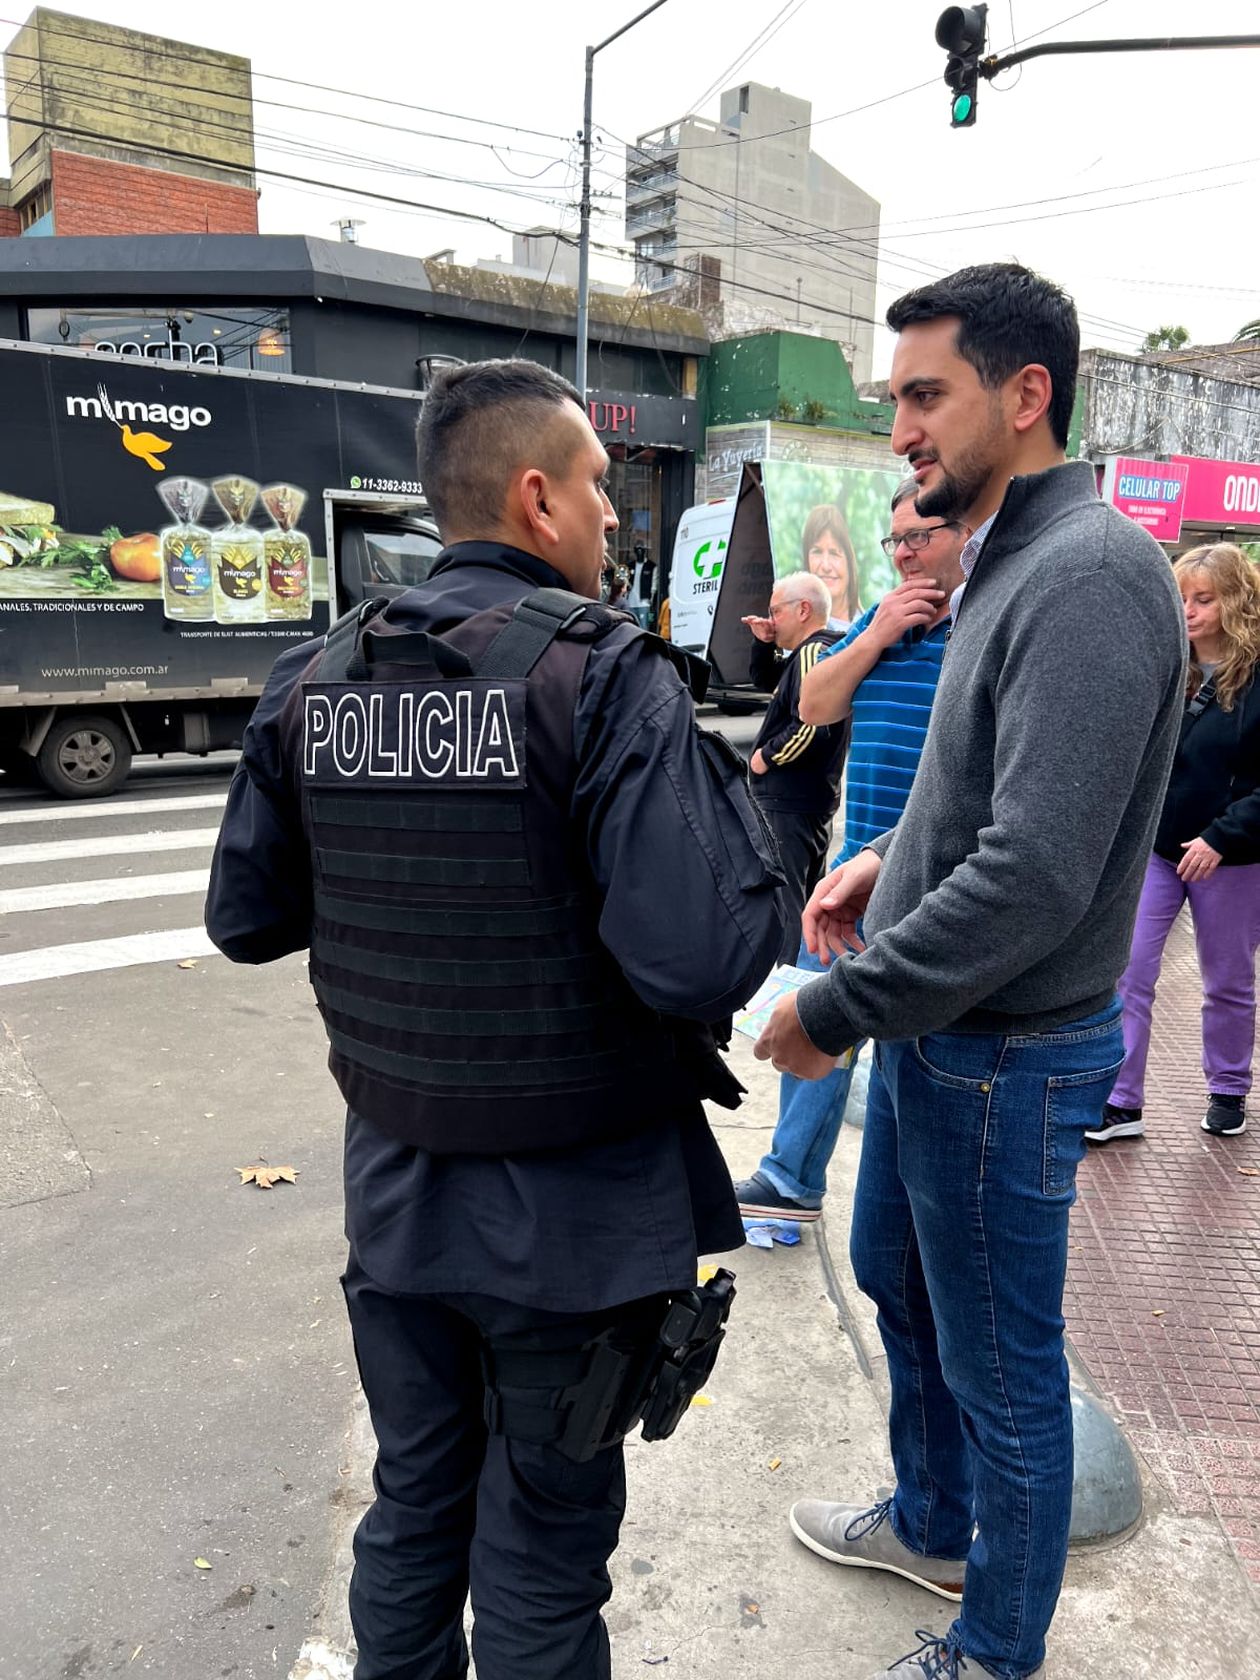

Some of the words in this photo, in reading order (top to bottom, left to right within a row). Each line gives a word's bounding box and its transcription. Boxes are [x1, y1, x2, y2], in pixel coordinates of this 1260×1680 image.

[66, 386, 212, 431] mimago
[589, 400, 637, 434] UP!
[362, 478, 423, 494] 11-3362-9333
[1119, 476, 1161, 499] CELULAR
[1162, 481, 1181, 500] TOP
[692, 579, 719, 596] STERIL
[33, 602, 96, 612] TRADICIONALES
[97, 602, 103, 611] Y
[104, 602, 115, 611] DE
[117, 602, 144, 612] CAMPO
[42, 665, 168, 678] www.mimago.com.ar
[304, 689, 519, 778] POLICIA
